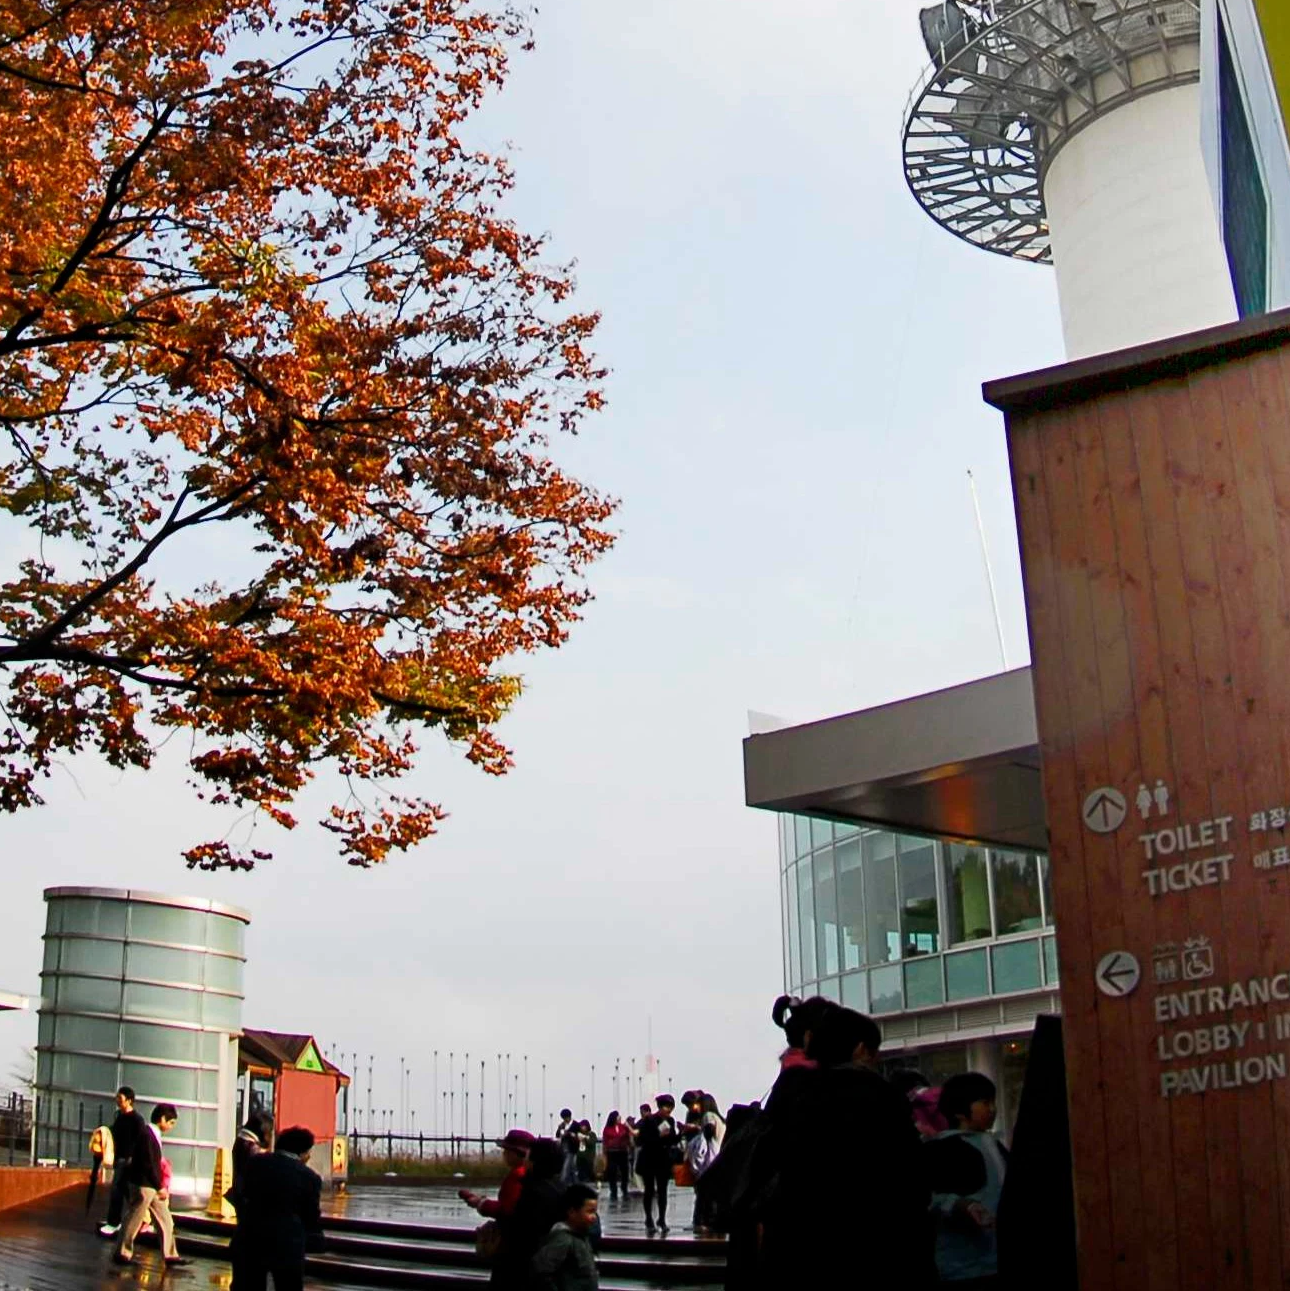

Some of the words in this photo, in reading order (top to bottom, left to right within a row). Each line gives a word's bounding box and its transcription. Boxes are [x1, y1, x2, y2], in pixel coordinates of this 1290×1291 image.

[1139, 817, 1232, 860] TOILET
[1143, 855, 1235, 896] TICKET
[1158, 1022, 1250, 1061] LOBBY
[1160, 1054, 1286, 1097] PAVILION
